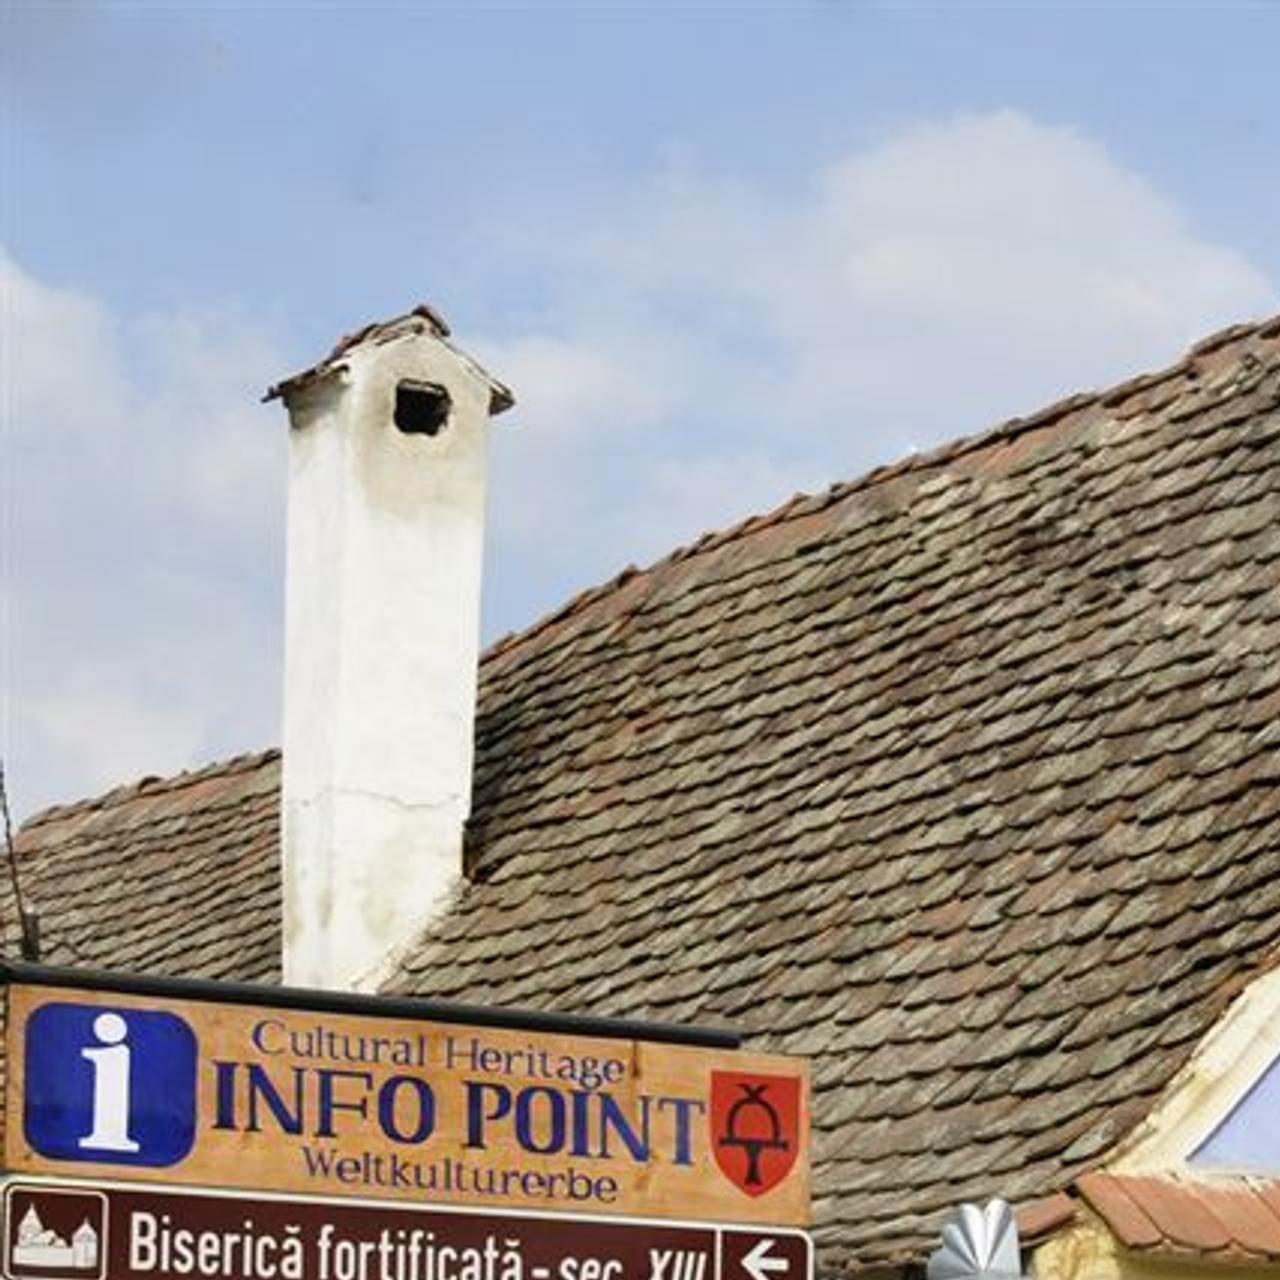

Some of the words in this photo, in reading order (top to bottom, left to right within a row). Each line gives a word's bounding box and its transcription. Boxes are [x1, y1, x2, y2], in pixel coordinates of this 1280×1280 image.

[78, 1012, 140, 1152] i
[252, 1020, 426, 1067] Cultural
[446, 1036, 625, 1089] Heritage
[211, 1060, 436, 1145] INFO
[461, 1080, 706, 1167] POINT
[302, 1146, 617, 1203] Weltkulturerbe
[129, 1211, 303, 1280] Biserică
